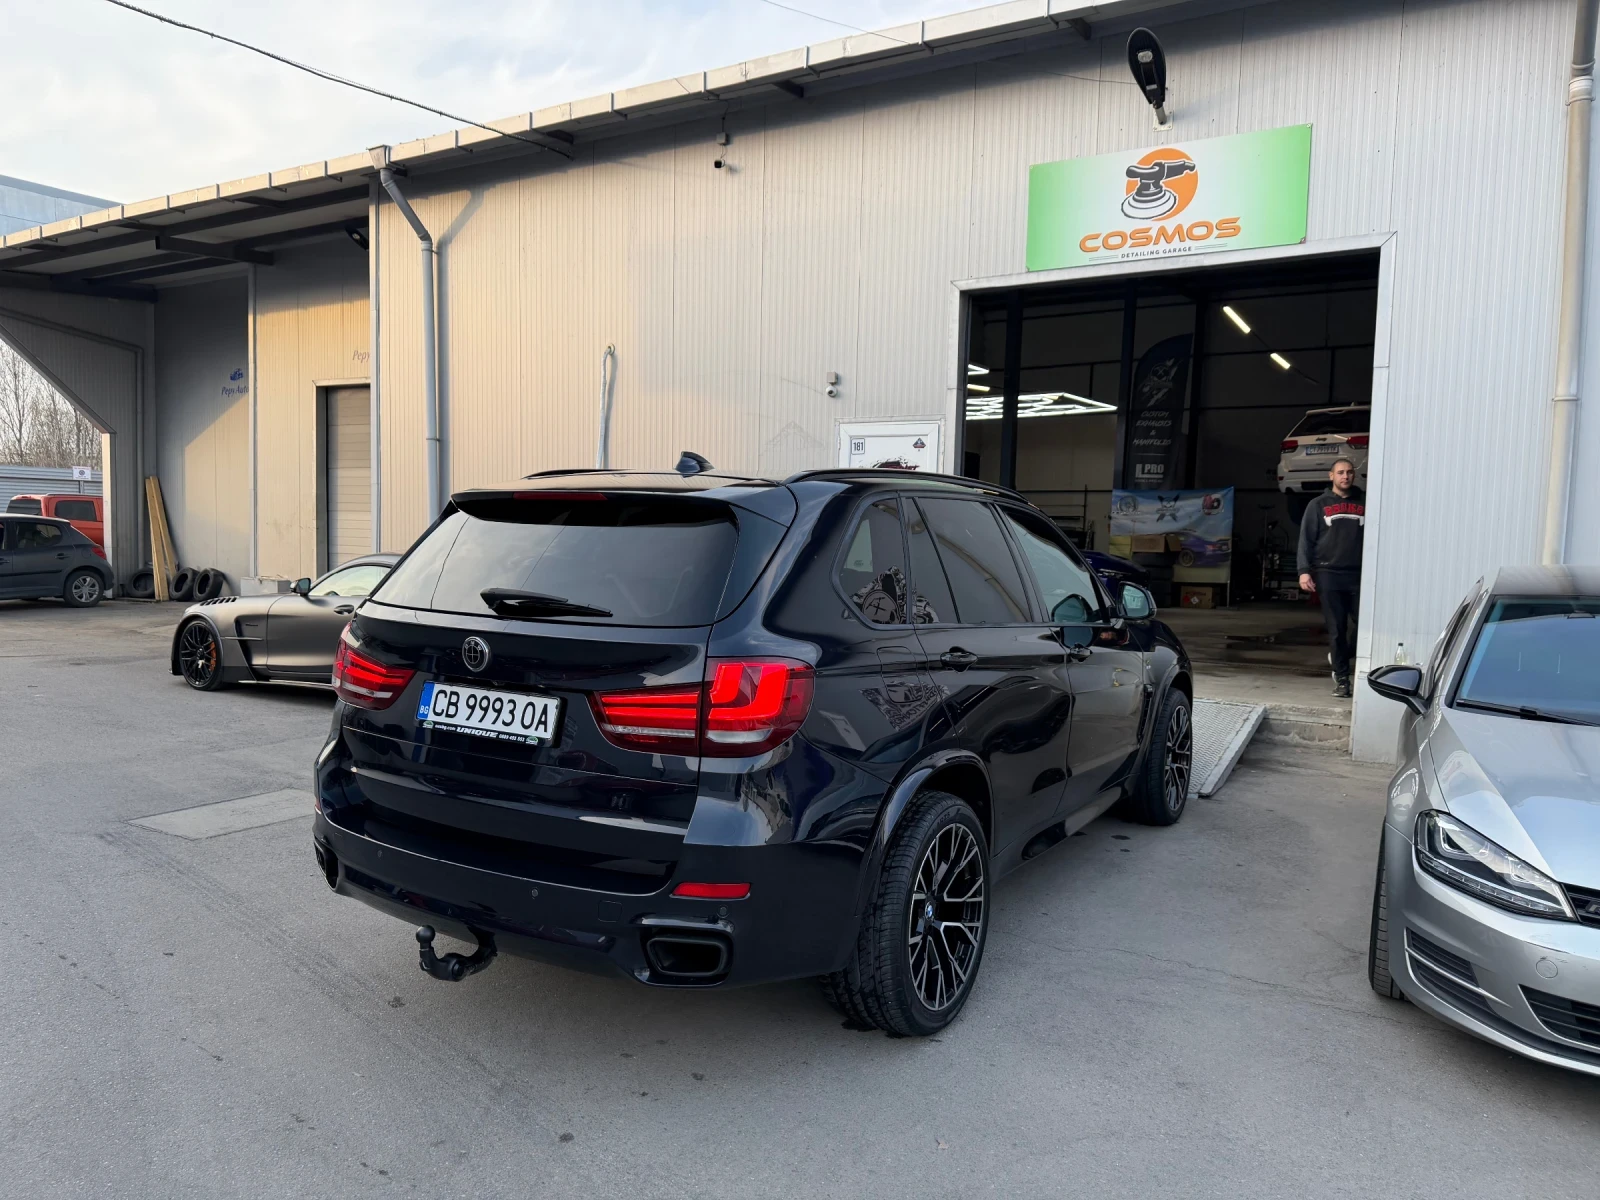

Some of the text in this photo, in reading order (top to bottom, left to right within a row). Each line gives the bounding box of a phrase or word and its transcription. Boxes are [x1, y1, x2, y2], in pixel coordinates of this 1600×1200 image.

[1079, 217, 1241, 253] COSMOS
[1121, 246, 1192, 259] DETAILING GARAGE
[853, 442, 864, 452] 181
[1133, 438, 1172, 446] MANIFOLDS
[419, 704, 429, 715] BG
[432, 689, 460, 719] CB
[465, 693, 517, 727] 9993
[456, 726, 498, 738] UNIQUE
